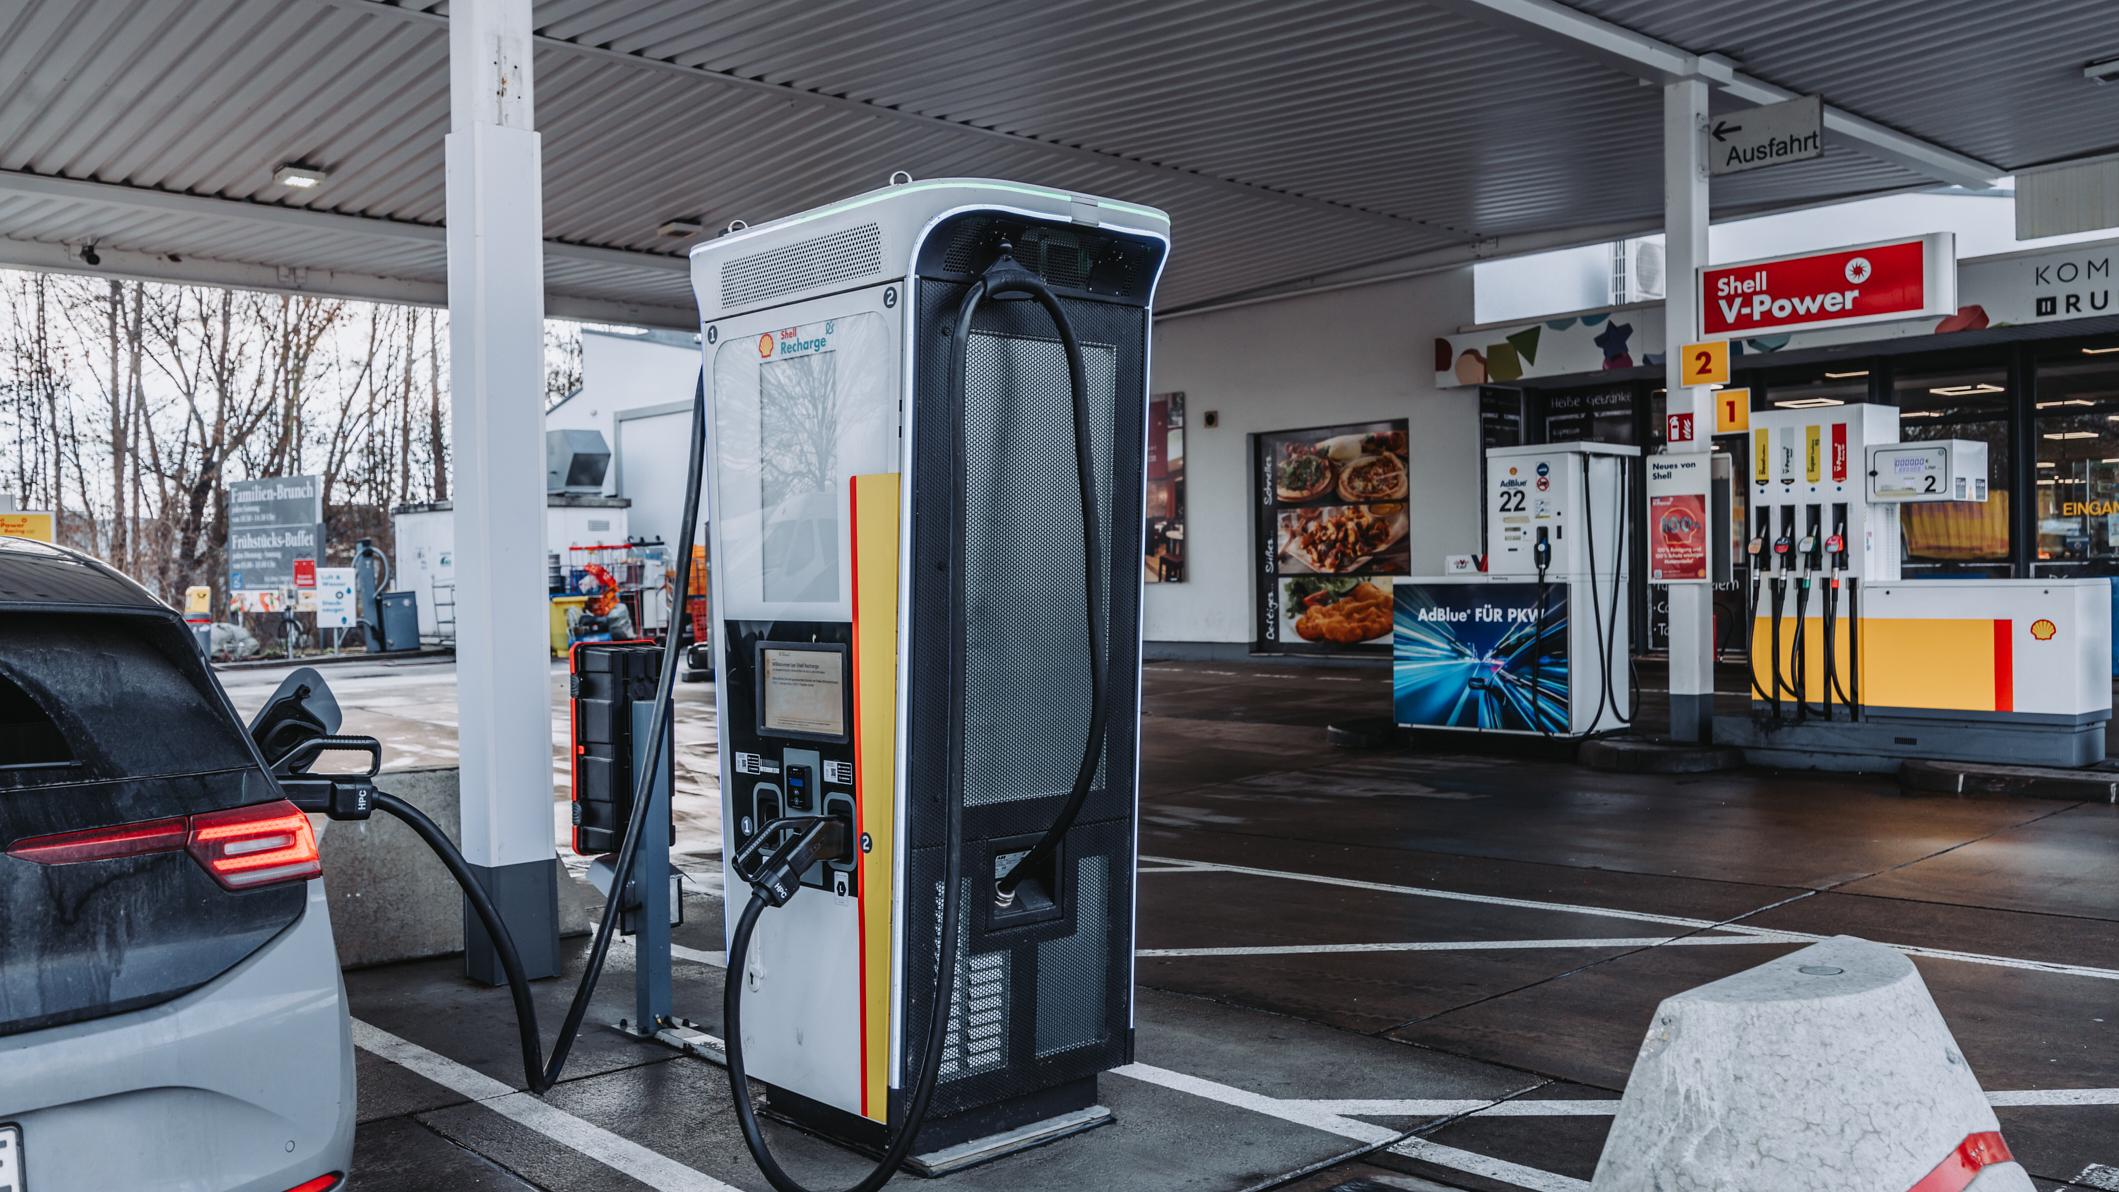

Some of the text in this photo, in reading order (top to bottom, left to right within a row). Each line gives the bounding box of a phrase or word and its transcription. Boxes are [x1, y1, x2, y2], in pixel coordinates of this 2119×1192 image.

[1726, 130, 1819, 167] Ausfahrt
[1717, 270, 1767, 297] Shell
[885, 289, 895, 306] 2
[1718, 288, 1859, 324] V-Power
[780, 327, 797, 340] Shell
[780, 337, 827, 354] Recharge
[1695, 351, 1712, 375] 2
[1726, 400, 1735, 423] 1
[1680, 461, 1696, 469] von
[1652, 471, 1672, 480] Shell
[1924, 475, 1937, 493] 2
[231, 480, 314, 503] Familien-Brunch
[1499, 490, 1526, 512] 22
[231, 530, 314, 550] Frühstücks-Buffet
[1475, 604, 1503, 622] FÜR
[358, 790, 367, 810] HPC
[774, 882, 788, 899] HPC
